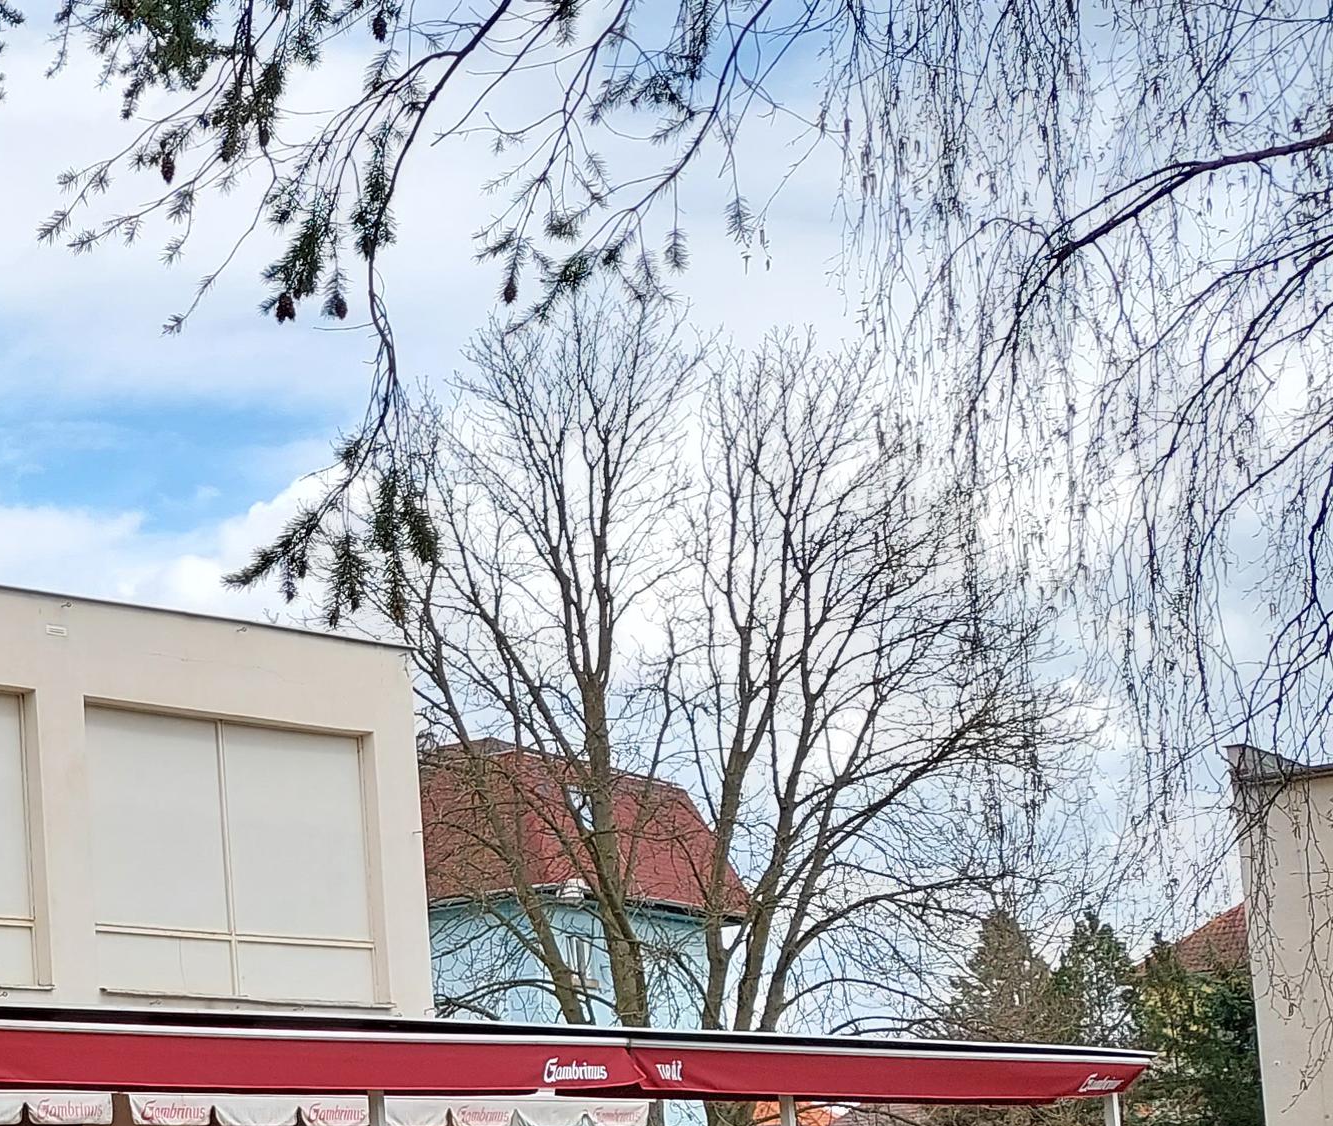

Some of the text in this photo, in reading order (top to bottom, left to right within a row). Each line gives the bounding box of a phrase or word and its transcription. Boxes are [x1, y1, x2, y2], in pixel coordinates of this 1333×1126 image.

[543, 1056, 609, 1084] Gambrinus
[37, 1099, 103, 1119] Gambrinus
[141, 1099, 206, 1121] Gambrinus
[308, 1102, 367, 1123] Gambrinus
